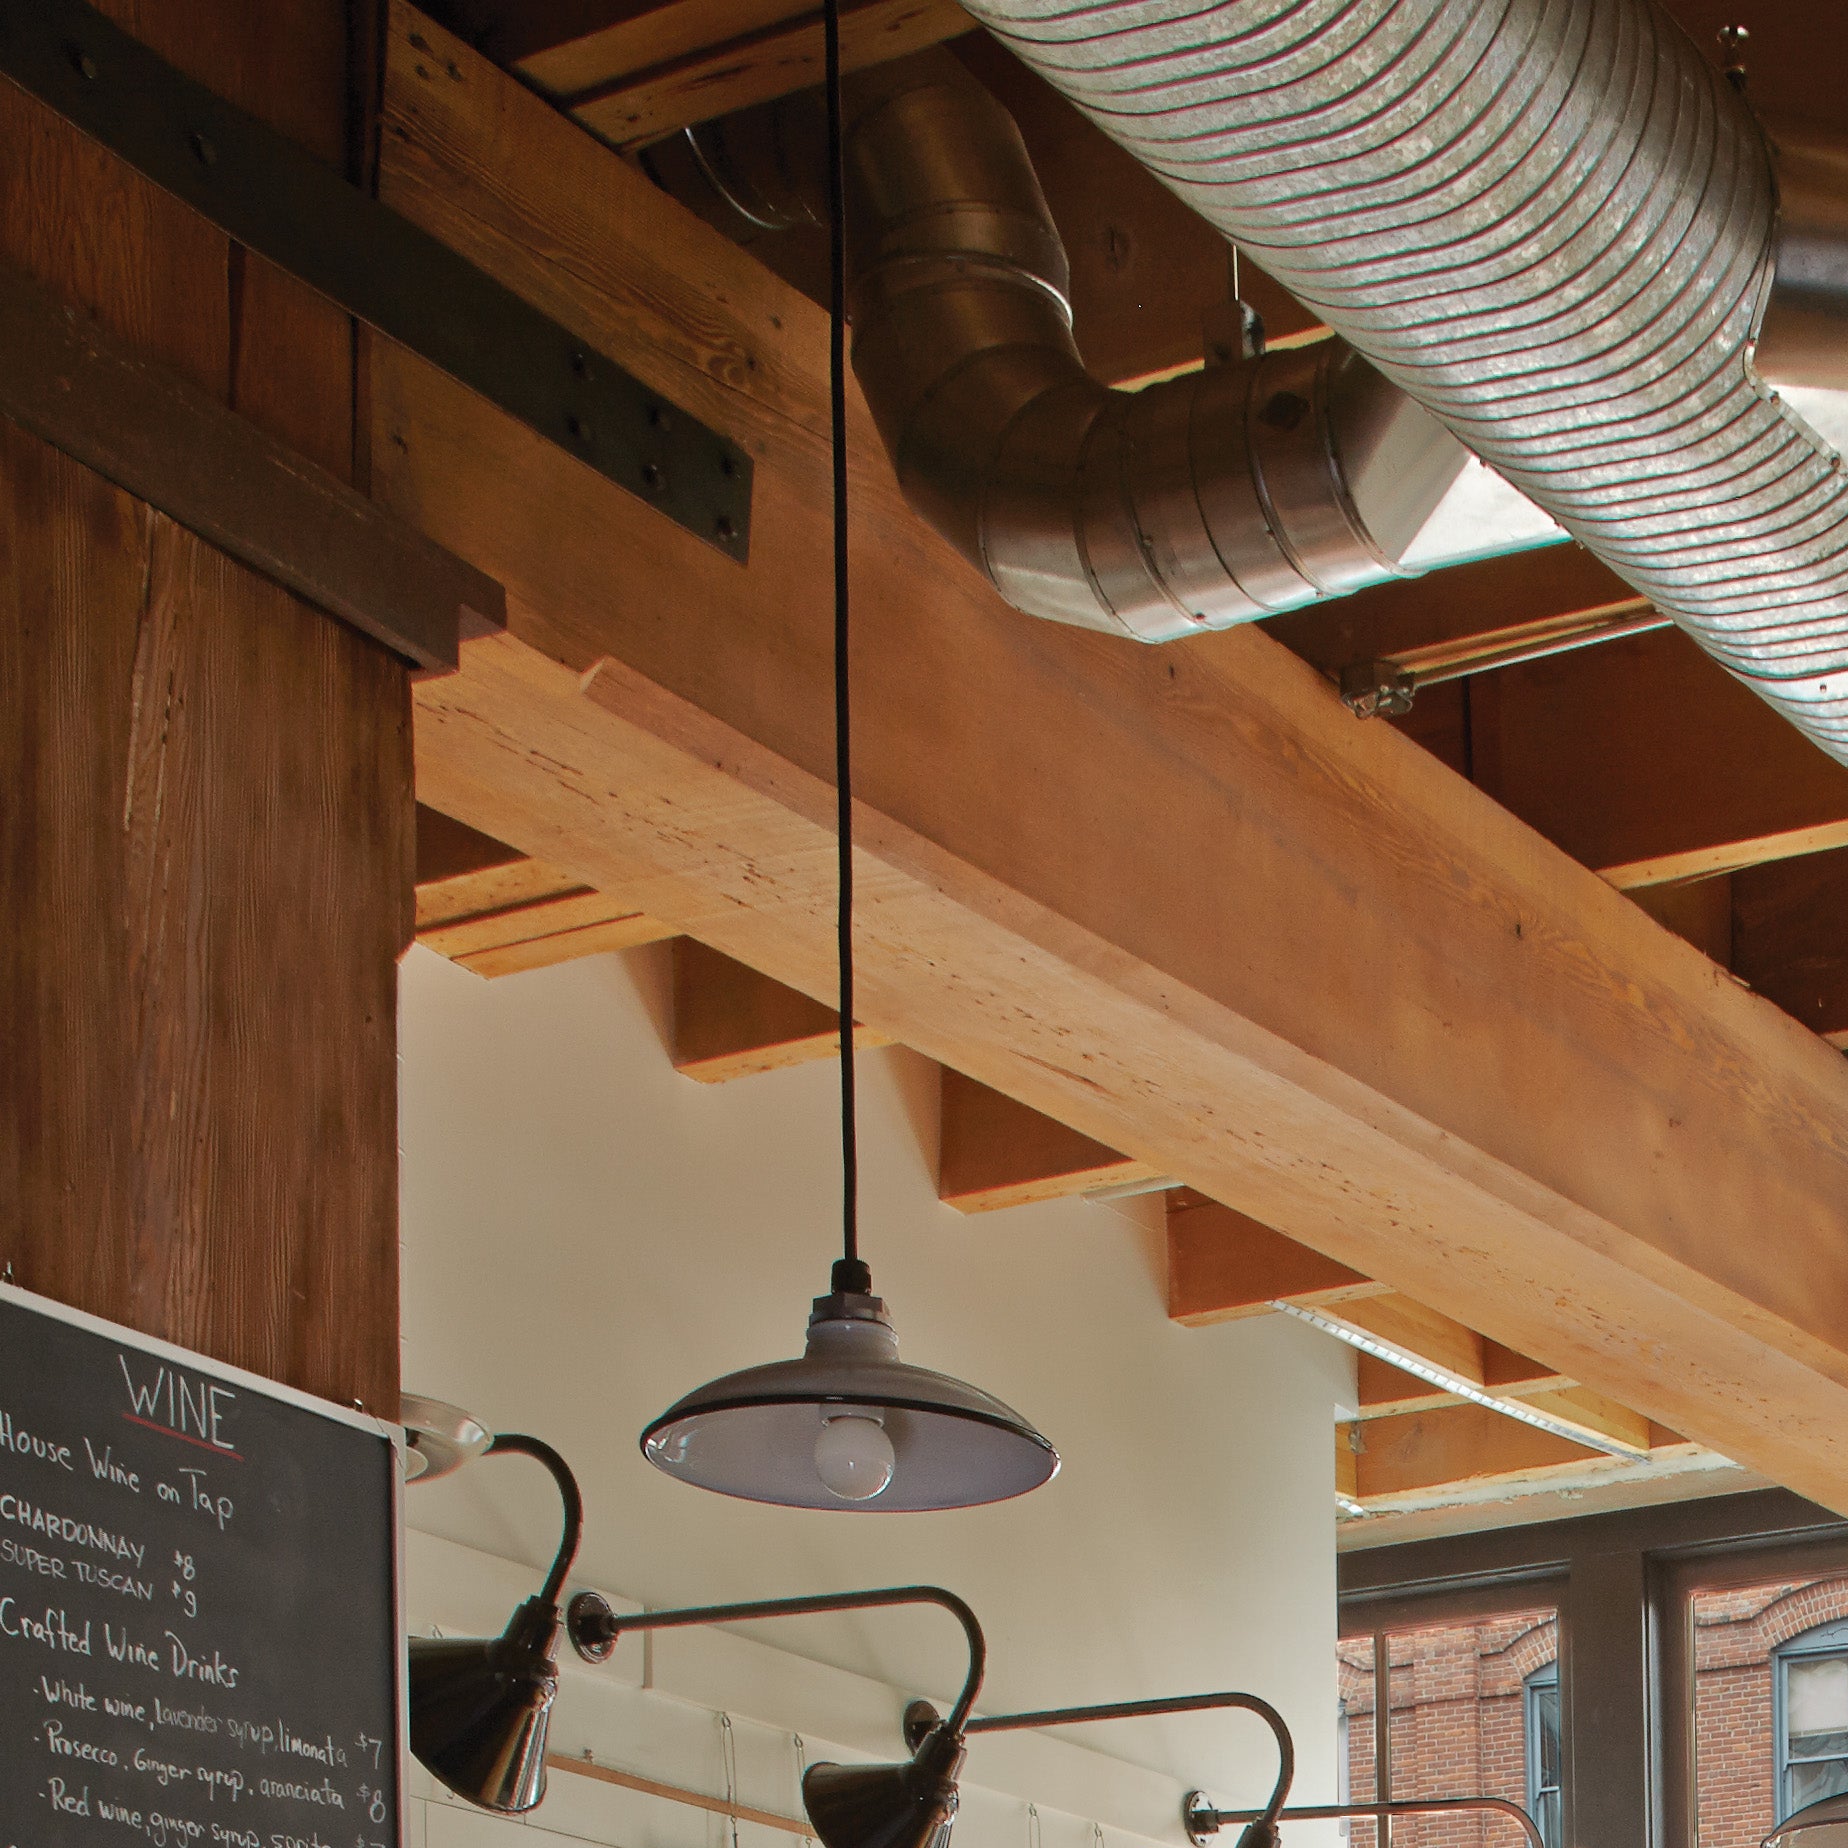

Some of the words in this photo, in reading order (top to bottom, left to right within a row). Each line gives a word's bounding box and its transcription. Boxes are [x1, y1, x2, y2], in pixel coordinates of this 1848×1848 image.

[117, 1354, 236, 1450] WINE
[0, 1410, 73, 1470] House
[83, 1436, 140, 1493] Wine
[157, 1483, 180, 1504] on
[179, 1468, 234, 1530] Tap
[0, 1495, 145, 1568] CHARDONNAY
[1, 1539, 67, 1579] SUPER
[71, 1561, 153, 1600] TUSCAN
[0, 1597, 91, 1656] Crafted
[104, 1624, 160, 1672] Wine
[165, 1631, 239, 1689] Drinks
[41, 1676, 97, 1712] White
[278, 1718, 348, 1768] limonata
[355, 1732, 382, 1770] $7
[49, 1777, 91, 1817] Red
[150, 1810, 205, 1848] ginger
[133, 1748, 192, 1787] Ginger
[260, 1778, 346, 1810] aranciata
[356, 1783, 386, 1824] $8
